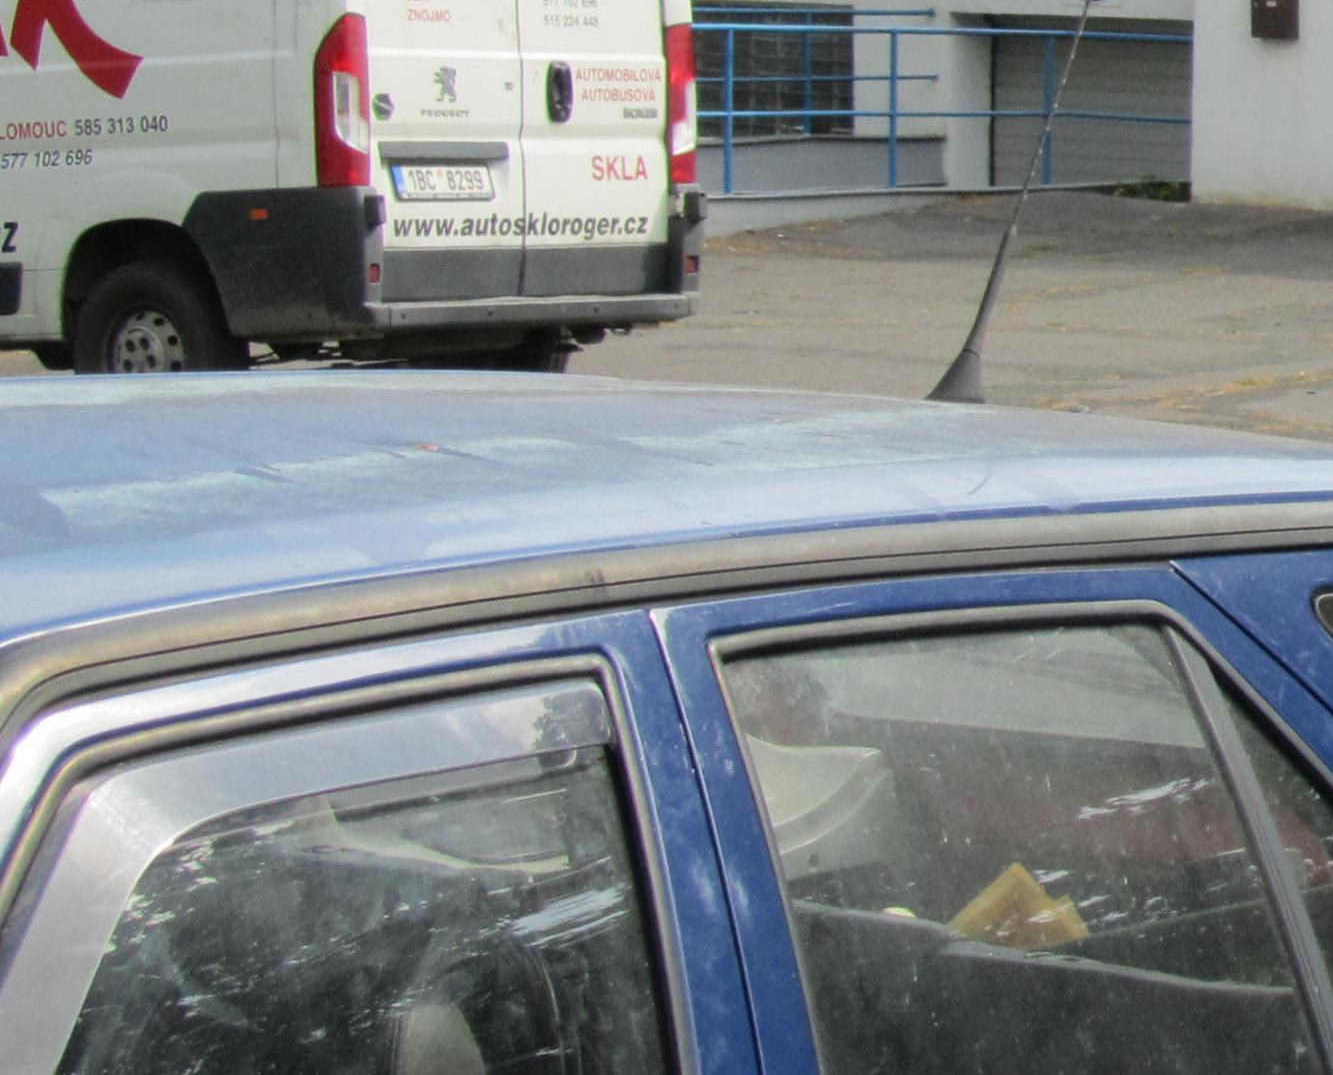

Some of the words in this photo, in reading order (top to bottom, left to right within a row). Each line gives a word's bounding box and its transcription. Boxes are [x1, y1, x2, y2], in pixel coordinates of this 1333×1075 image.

[408, 9, 452, 23] ZNOJMO
[420, 109, 470, 118] PEUGEOT
[75, 118, 102, 136] 585
[107, 117, 135, 135] 313
[140, 115, 168, 133] 040
[0, 152, 28, 169] 577
[34, 151, 61, 167] 102
[65, 149, 93, 166] 696
[591, 155, 648, 182] SKLA
[408, 169, 437, 191] 1BC
[446, 169, 485, 191] 8299
[393, 211, 648, 240] www.autoskloroger.cz
